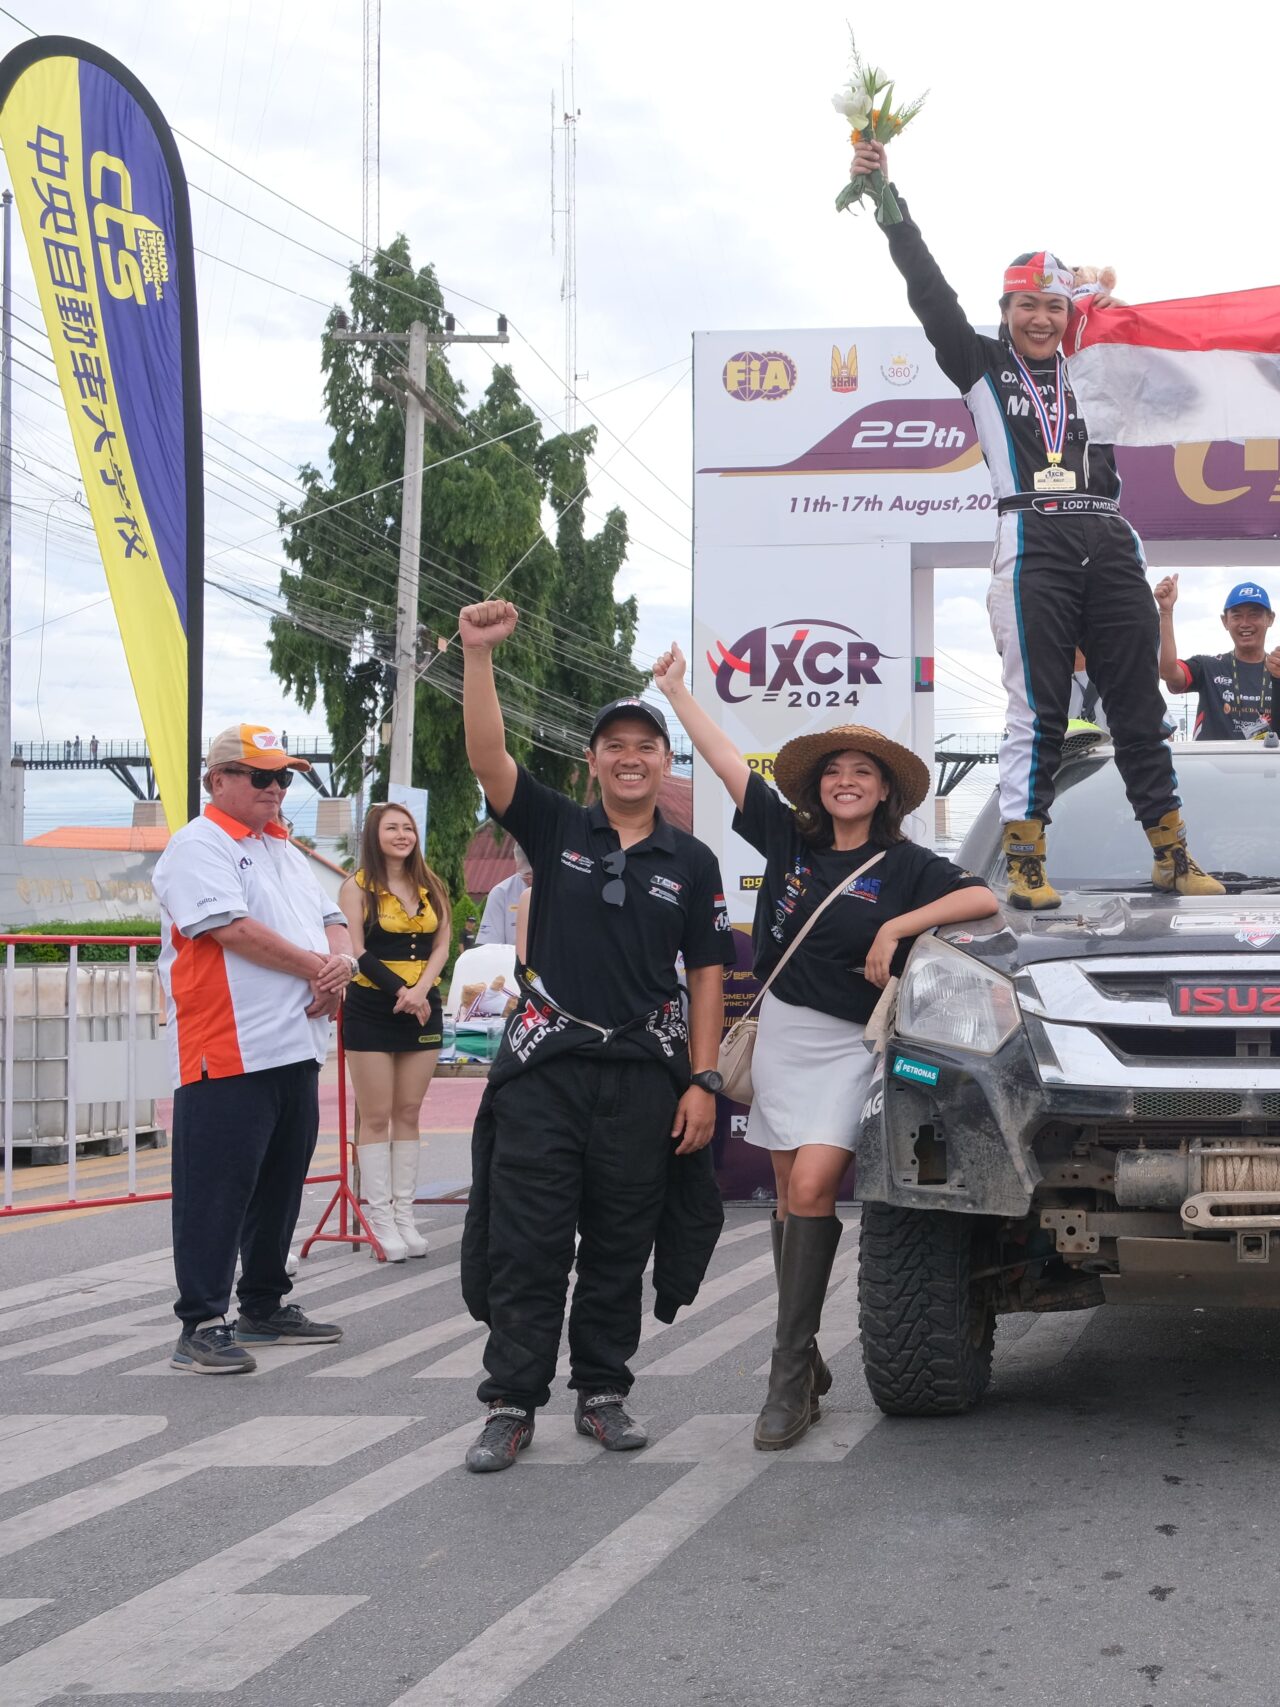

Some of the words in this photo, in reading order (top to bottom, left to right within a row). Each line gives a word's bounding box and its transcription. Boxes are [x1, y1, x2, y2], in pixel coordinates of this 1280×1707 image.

[137, 230, 152, 285] SCHOOL
[852, 420, 966, 448] 29th
[790, 496, 883, 514] 11th-17th
[889, 493, 1000, 516] August,202
[1063, 501, 1089, 510] LODY
[706, 626, 883, 704] AXCR
[787, 691, 860, 707] 2024
[902, 1063, 937, 1081] PETRONAS
